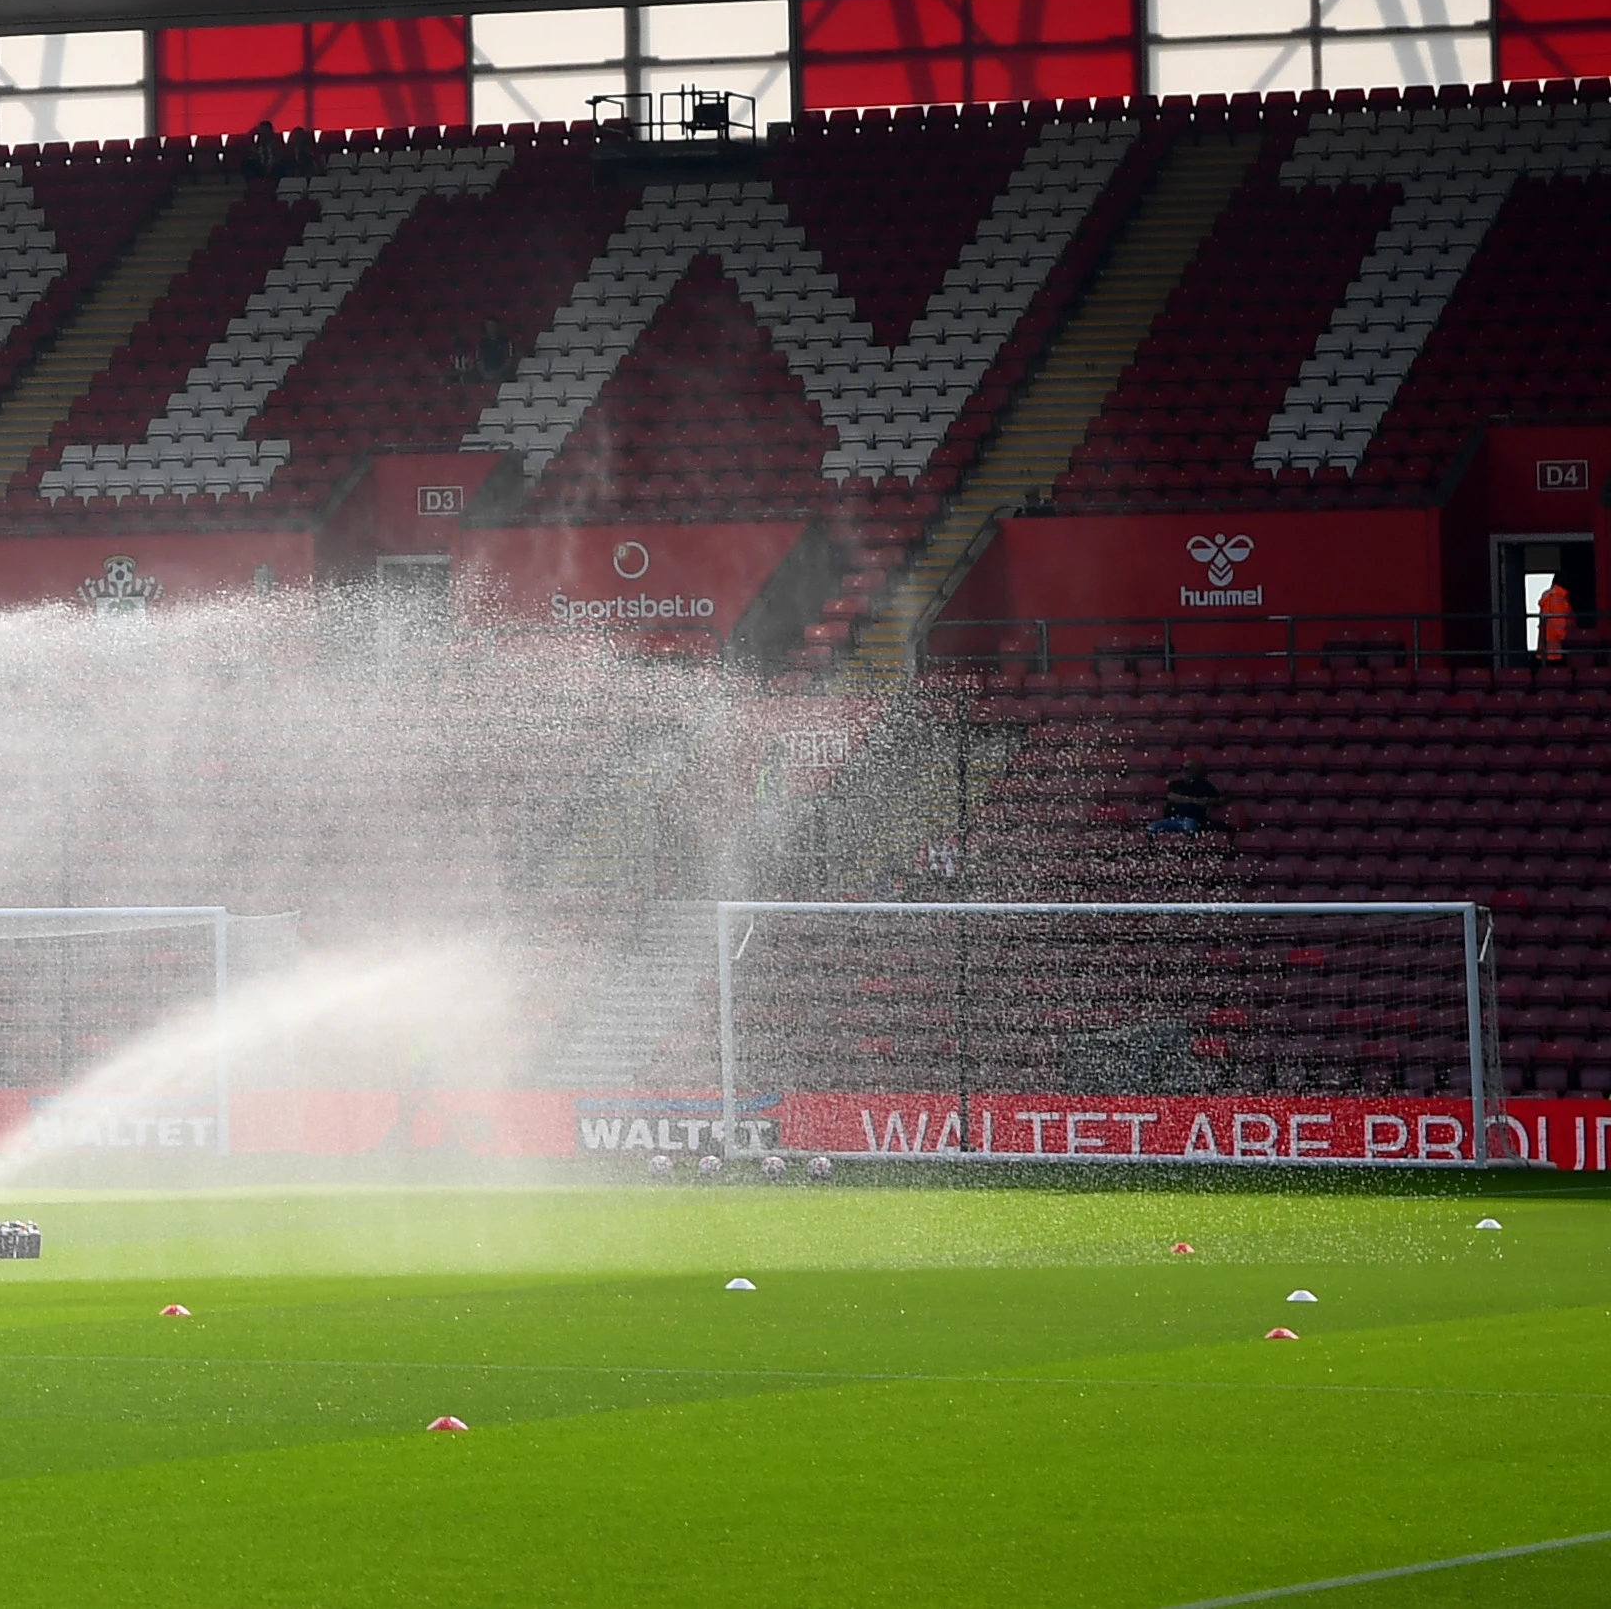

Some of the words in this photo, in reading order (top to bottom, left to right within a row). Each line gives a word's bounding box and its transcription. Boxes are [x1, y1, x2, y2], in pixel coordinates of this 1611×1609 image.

[1546, 465, 1579, 487] D4
[426, 490, 455, 511] D3
[1180, 585, 1263, 607] hummel
[550, 593, 715, 624] Sportsbet.io
[861, 1109, 1158, 1156] WALTET
[1183, 1112, 1333, 1159] ARE
